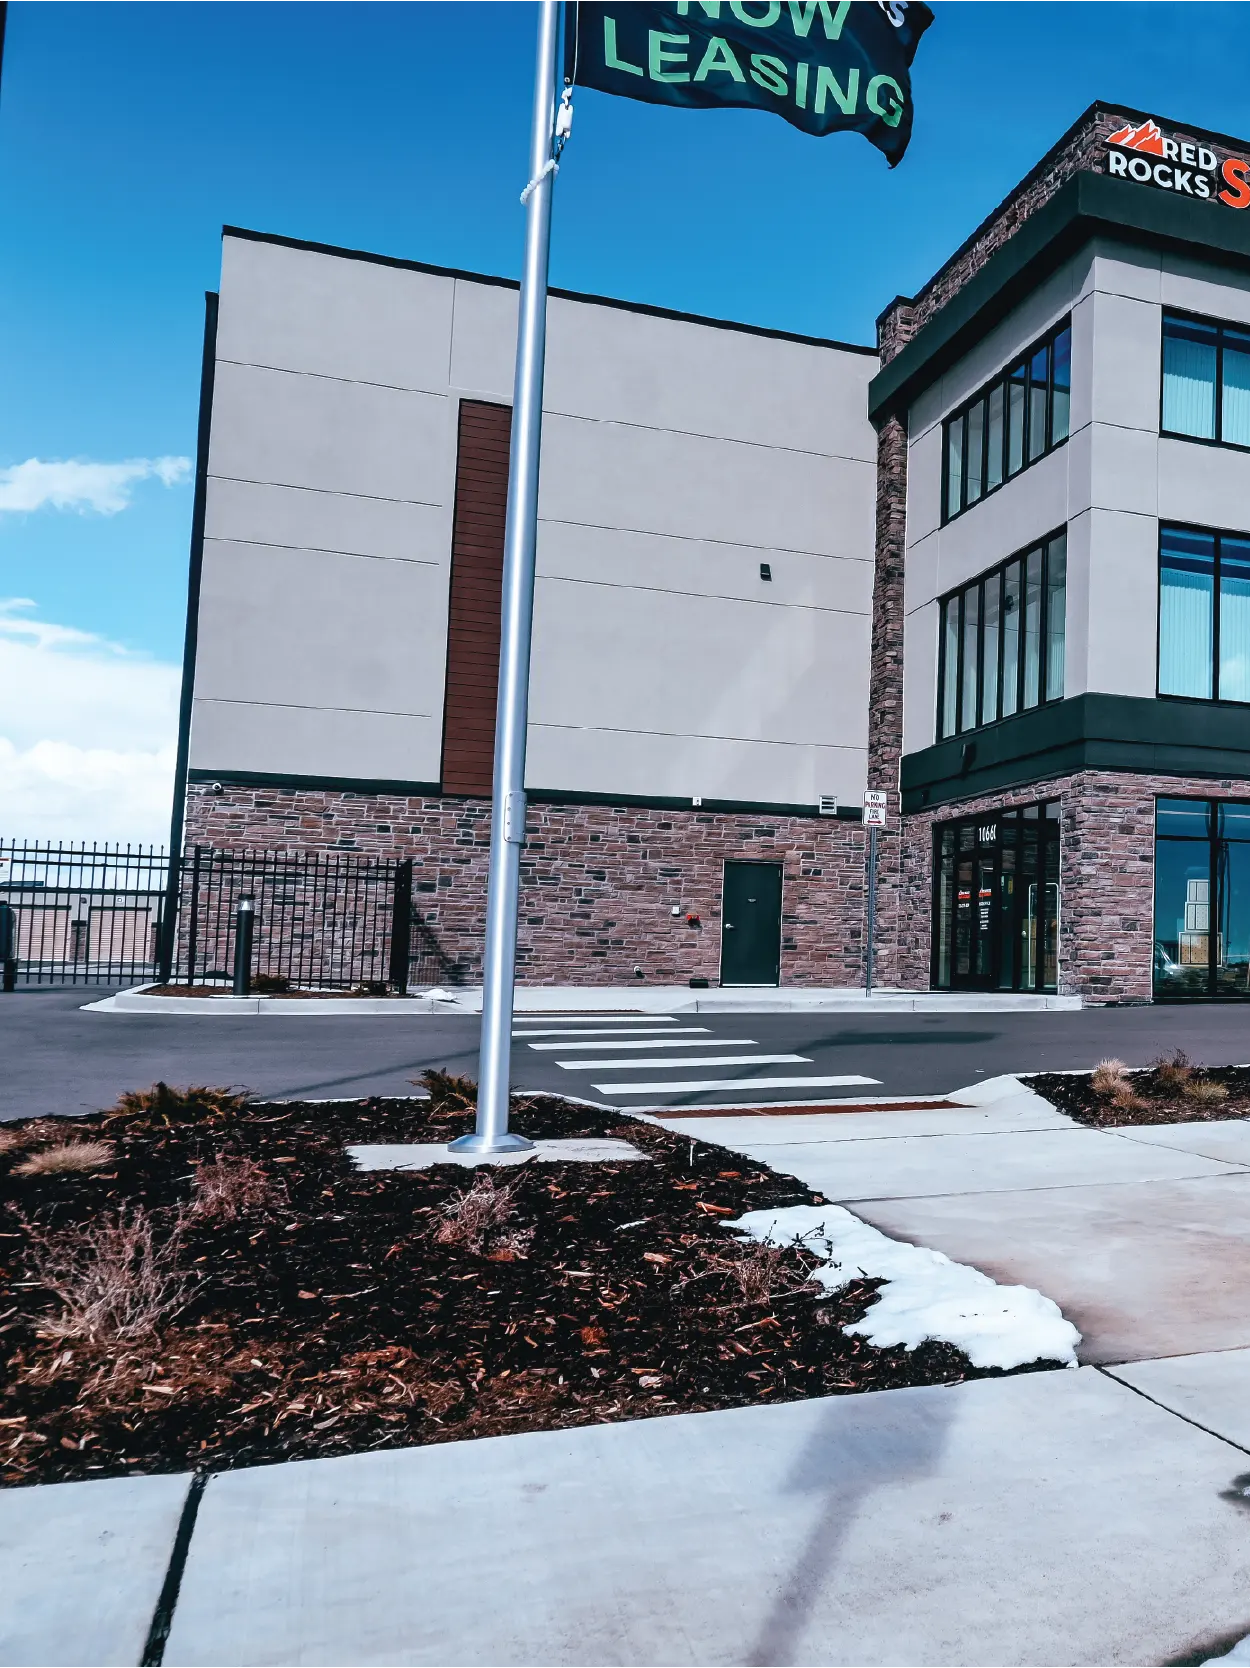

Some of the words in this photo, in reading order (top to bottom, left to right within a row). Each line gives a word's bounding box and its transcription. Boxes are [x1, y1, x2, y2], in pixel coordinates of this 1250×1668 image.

[604, 15, 904, 128] LEASING
[1108, 150, 1211, 198] ROCKS
[1162, 138, 1218, 171] RED
[865, 801, 885, 809] PARKING
